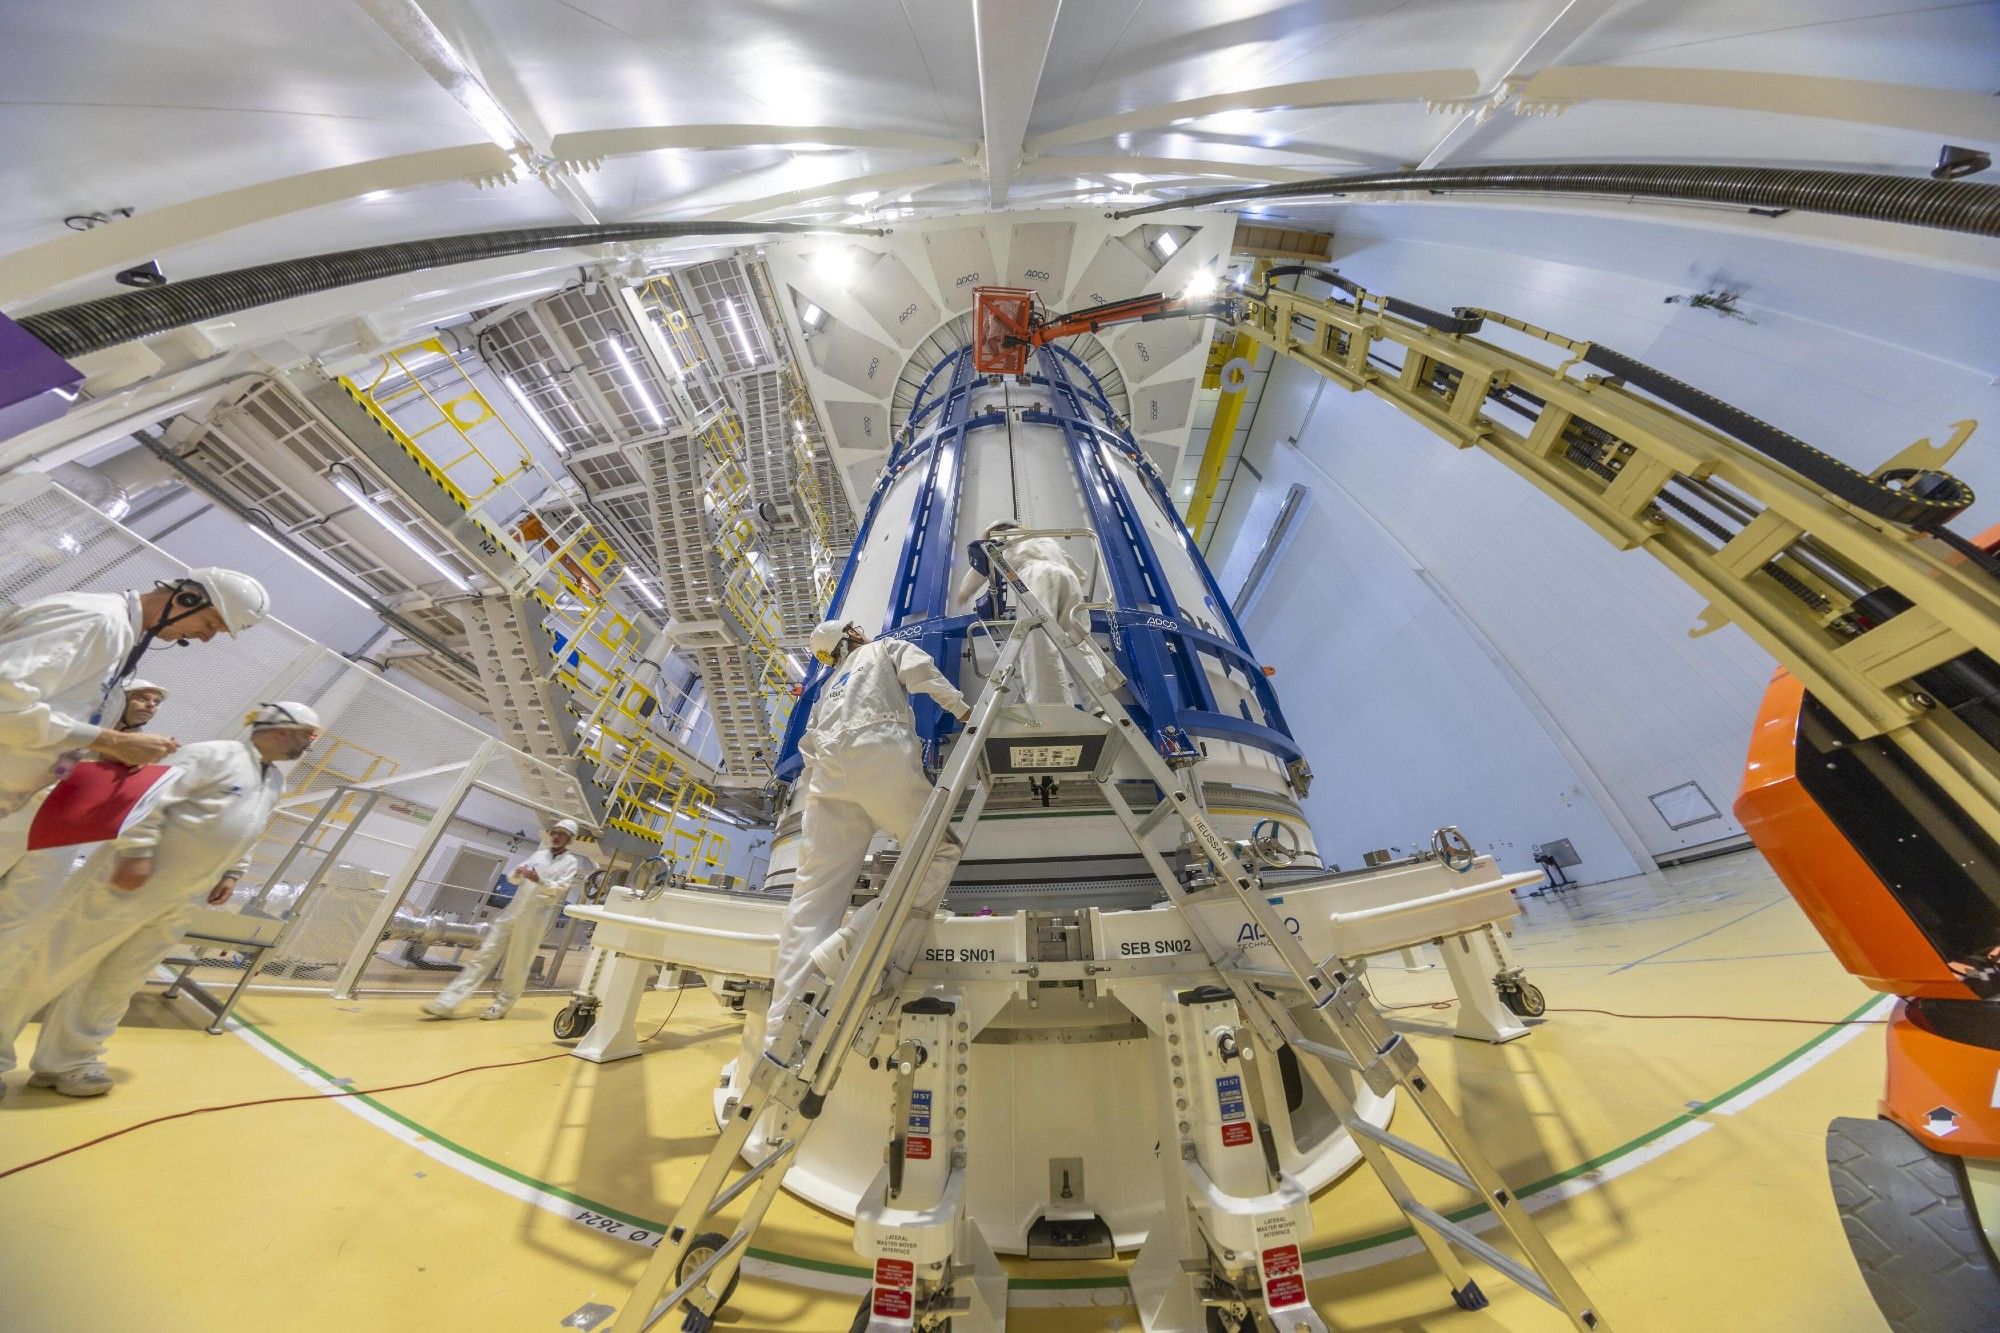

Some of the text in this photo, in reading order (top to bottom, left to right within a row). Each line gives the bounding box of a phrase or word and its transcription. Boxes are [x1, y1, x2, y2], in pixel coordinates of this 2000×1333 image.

[1121, 939, 1192, 956] SEB SN02
[926, 949, 995, 962] SEB SN01
[576, 1211, 624, 1233] 2624
[1256, 1221, 1296, 1233] MASTER MOVER
[1264, 1217, 1287, 1225] LATERAL
[876, 1239, 898, 1248] MASTER
[885, 1234, 909, 1242] LATERAL
